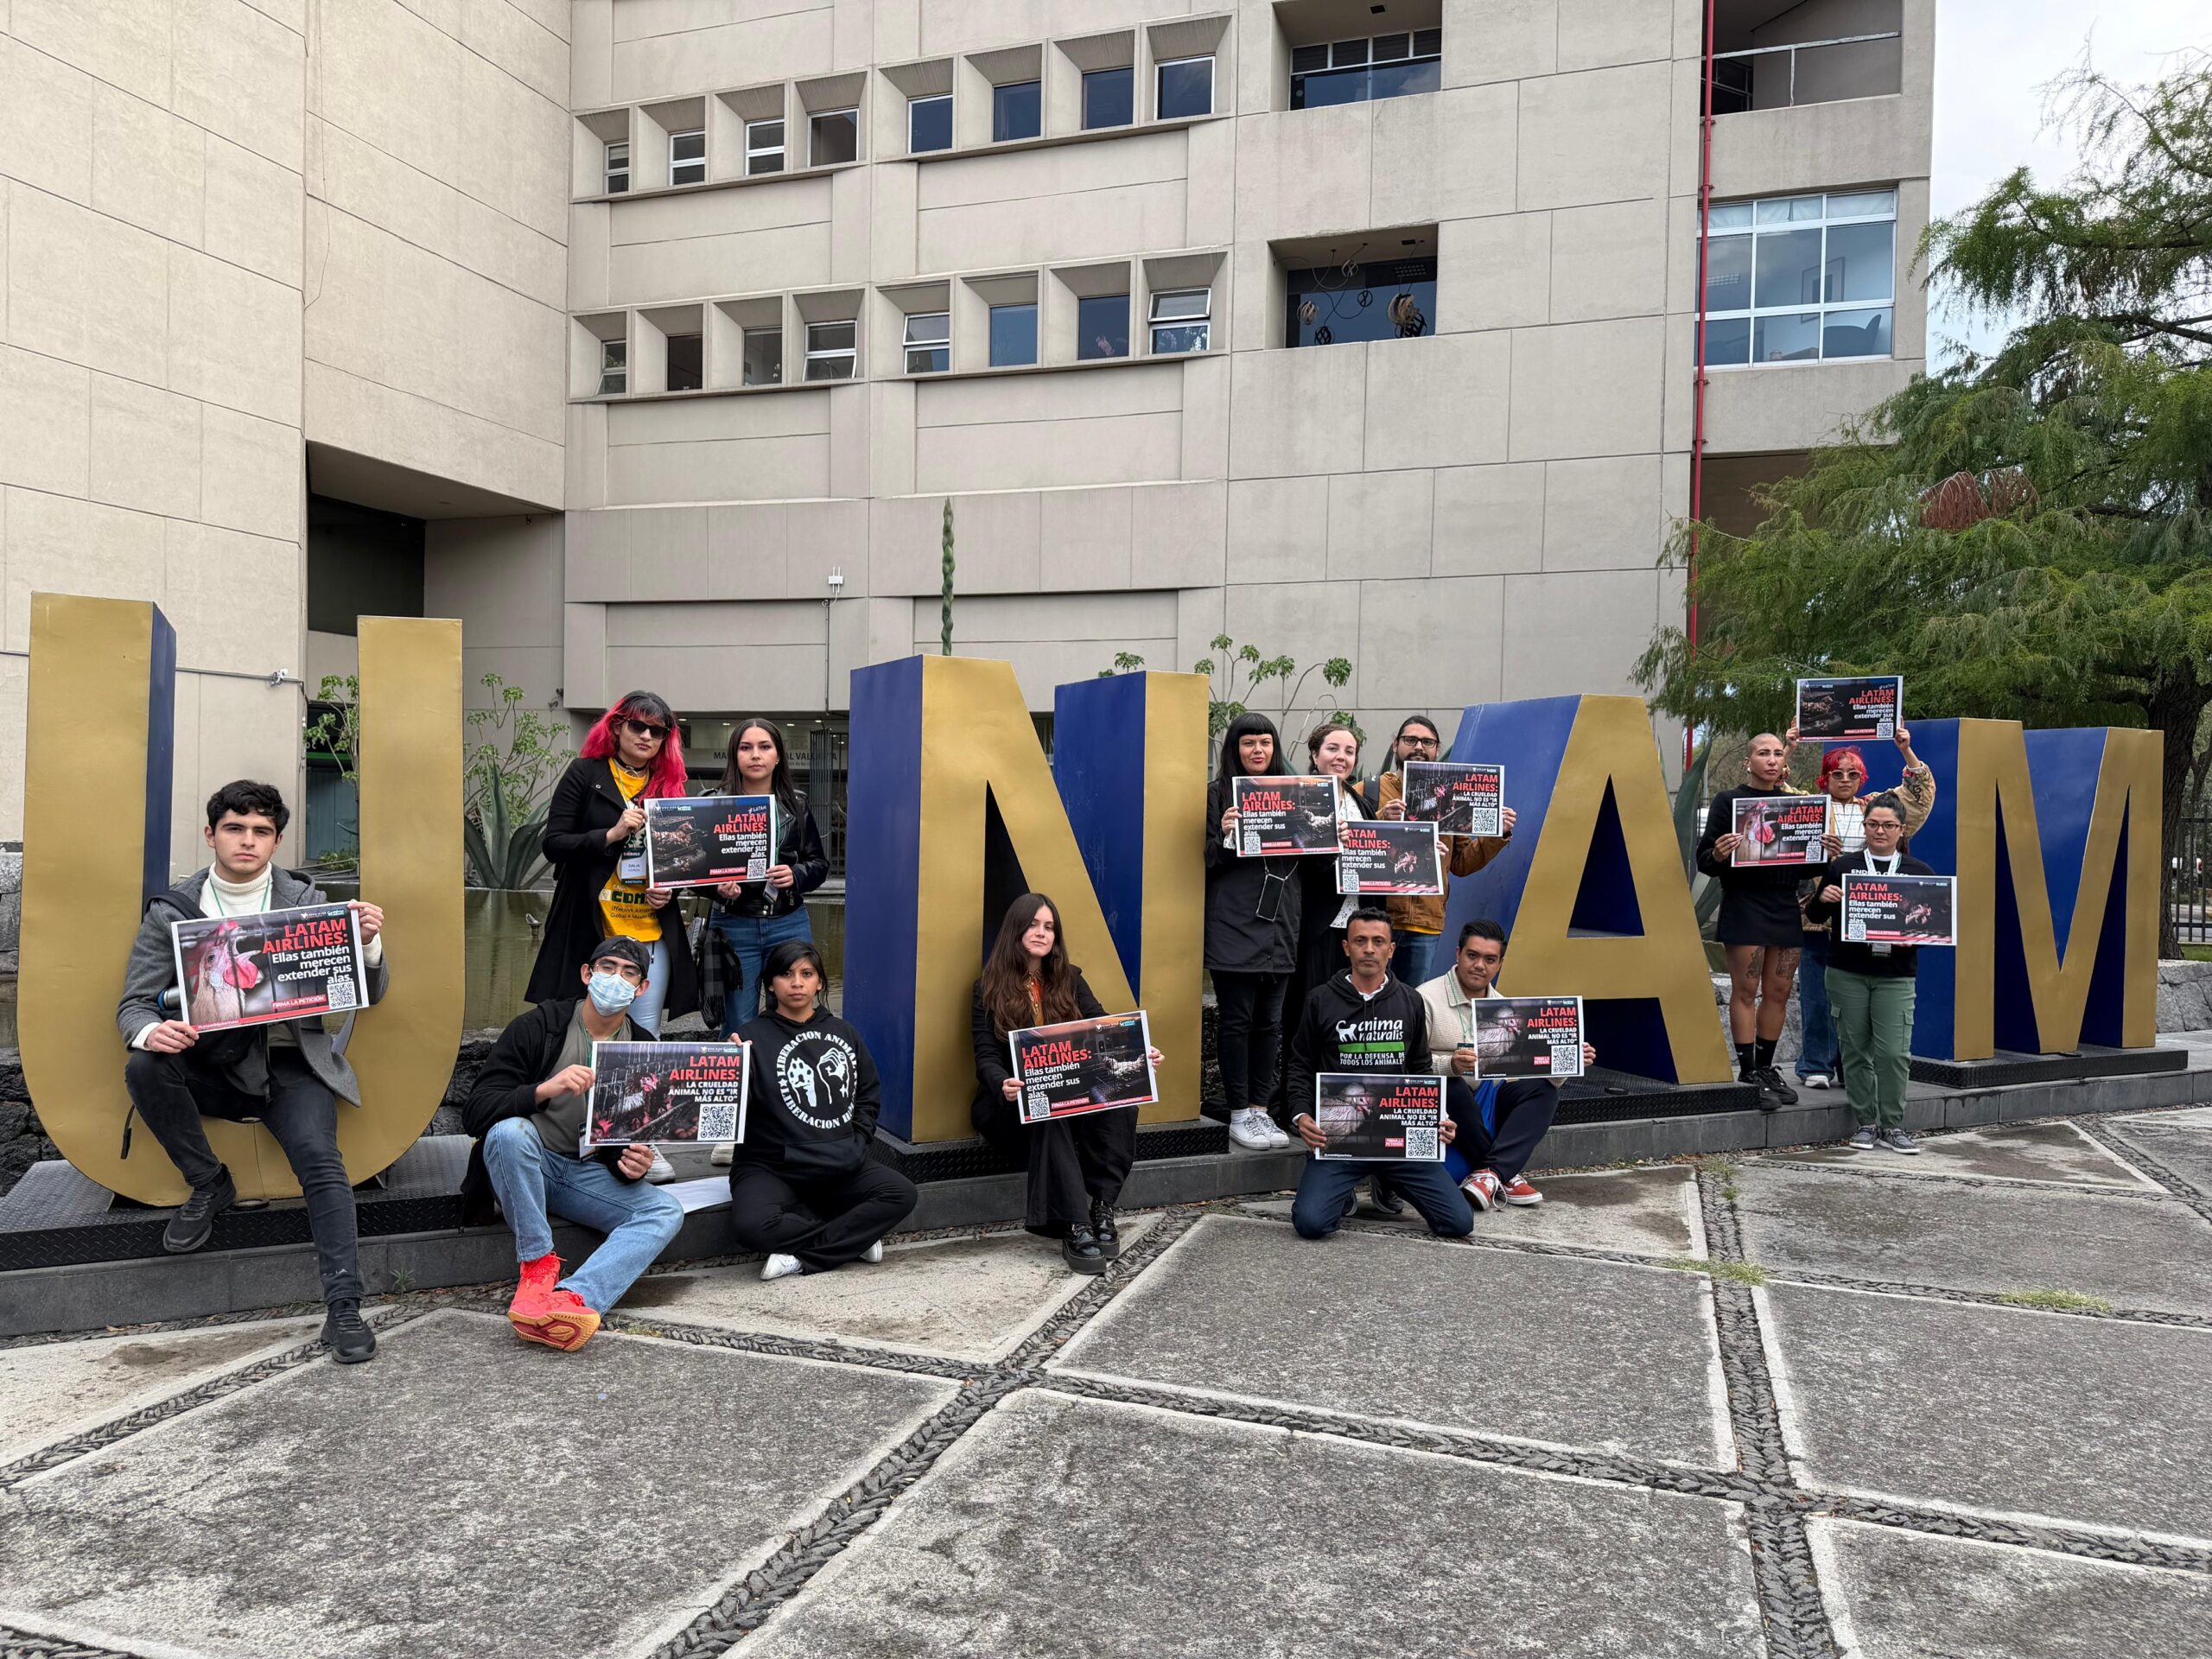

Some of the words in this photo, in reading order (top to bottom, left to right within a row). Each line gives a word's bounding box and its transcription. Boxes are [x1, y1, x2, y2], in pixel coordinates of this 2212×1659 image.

[1849, 696, 1894, 705] AIRLINES:
[1465, 774, 1498, 783] LATAM
[1452, 783, 1498, 792] AIRLINES:
[1242, 791, 1281, 802] LATAM
[1243, 800, 1296, 810] AIRLINES:
[1790, 805, 1823, 815] LATAM
[728, 814, 766, 823] LATAM
[1777, 814, 1823, 823] AIRLINES:
[714, 823, 767, 834] AIRLINES:
[1348, 830, 1376, 838] ATAM
[1346, 839, 1391, 849] IRLINES:
[721, 845, 753, 854] extender
[1849, 883, 1887, 892] LATAM
[18, 593, 2164, 1206] UNAM
[612, 891, 648, 904] CDM
[1849, 892, 1903, 901] AIRLINES:
[284, 918, 346, 938] LATAM
[263, 931, 348, 954] AIRLINES:
[272, 952, 299, 963] Ellas
[301, 945, 349, 959] también
[300, 956, 351, 969] merecen
[277, 965, 331, 982] extender
[333, 964, 352, 974] sus
[327, 973, 353, 983] alas.
[299, 995, 324, 1004] PETICIÓN
[1541, 1007, 1576, 1017] LATAM
[1528, 1018, 1577, 1027] AIRLINES:
[1359, 1030, 1403, 1042] naturalis
[777, 1031, 821, 1077] LIBERACION
[824, 1033, 857, 1069] ANIMAL
[1022, 1040, 1071, 1059] LATAM
[690, 1056, 740, 1067] LATAM
[1023, 1049, 1092, 1070] AIRLINES:
[669, 1069, 740, 1080] AIRLINES:
[1025, 1068, 1044, 1077] Ellas
[1045, 1062, 1080, 1074] también
[1026, 1074, 1063, 1084] merecen
[1027, 1079, 1064, 1092] extender
[1028, 1090, 1047, 1099] alas.
[1395, 1087, 1439, 1096] LATAM
[695, 1094, 712, 1103] MÁS
[1379, 1097, 1439, 1108] AIRLINES:
[780, 1088, 841, 1128] LIBERACION
